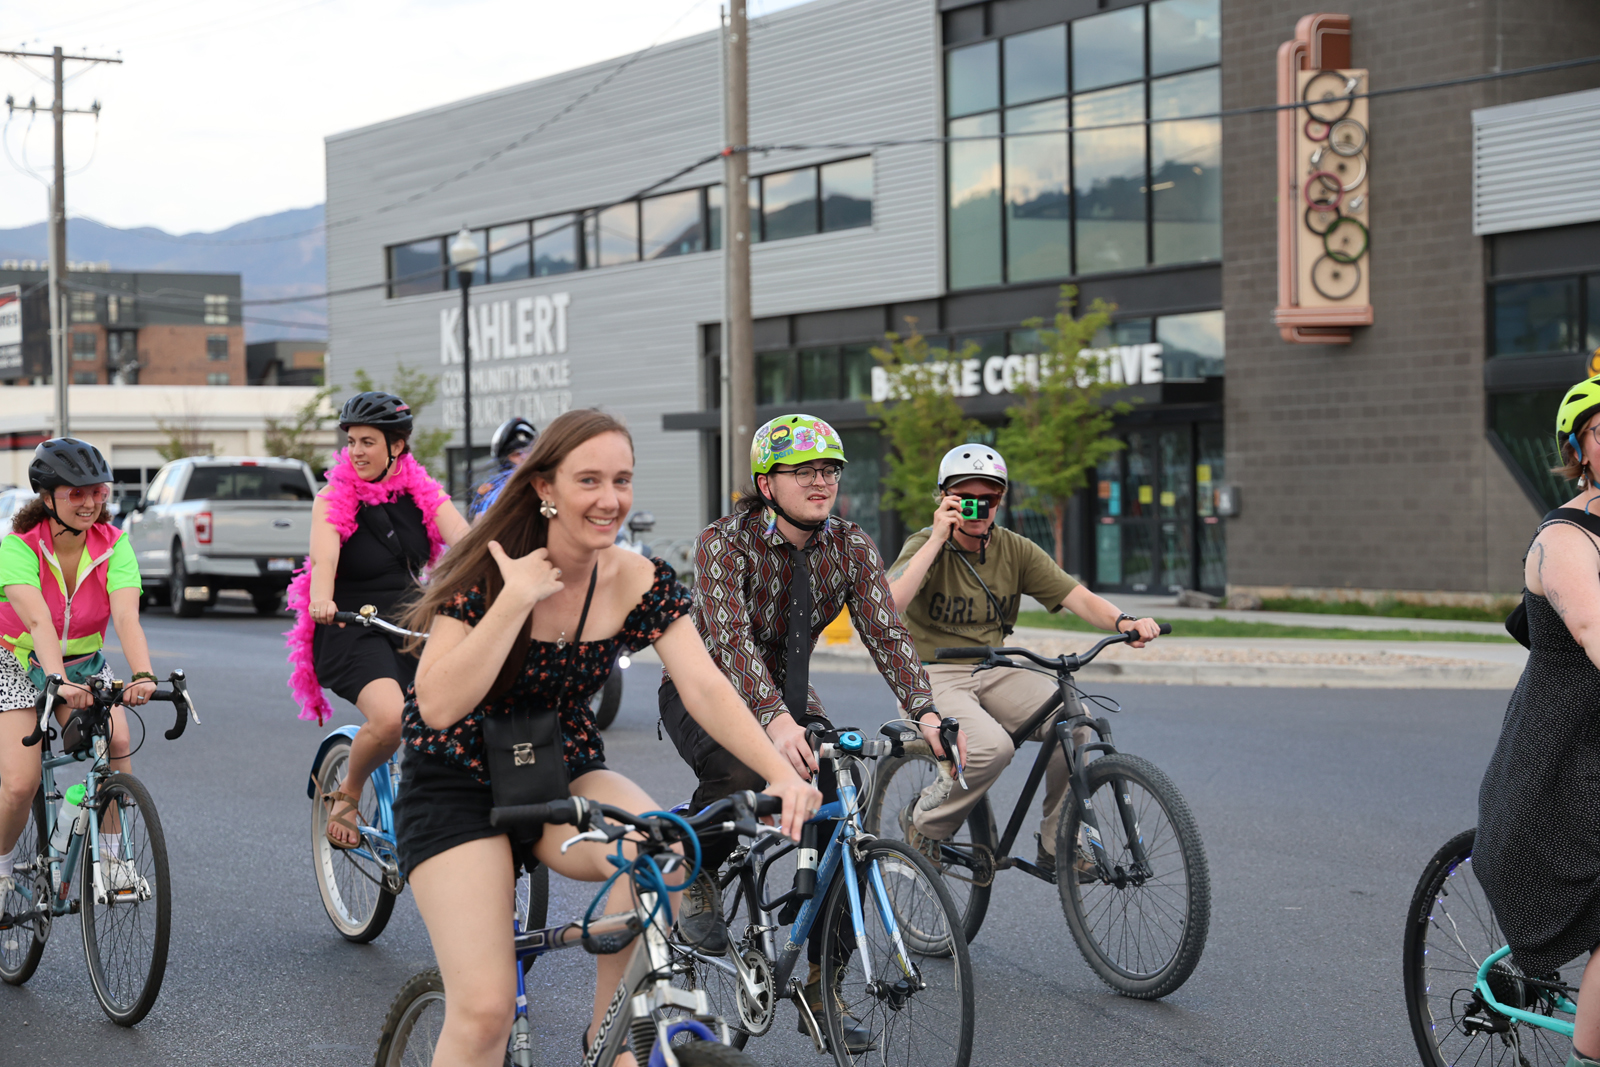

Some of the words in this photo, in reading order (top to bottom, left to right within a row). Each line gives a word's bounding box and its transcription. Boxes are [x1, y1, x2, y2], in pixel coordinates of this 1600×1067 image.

[440, 292, 570, 365] KAHLERT
[983, 342, 1163, 395] COLCTIVE
[928, 592, 977, 624] GIRL
[582, 983, 628, 1067] NGOOSE
